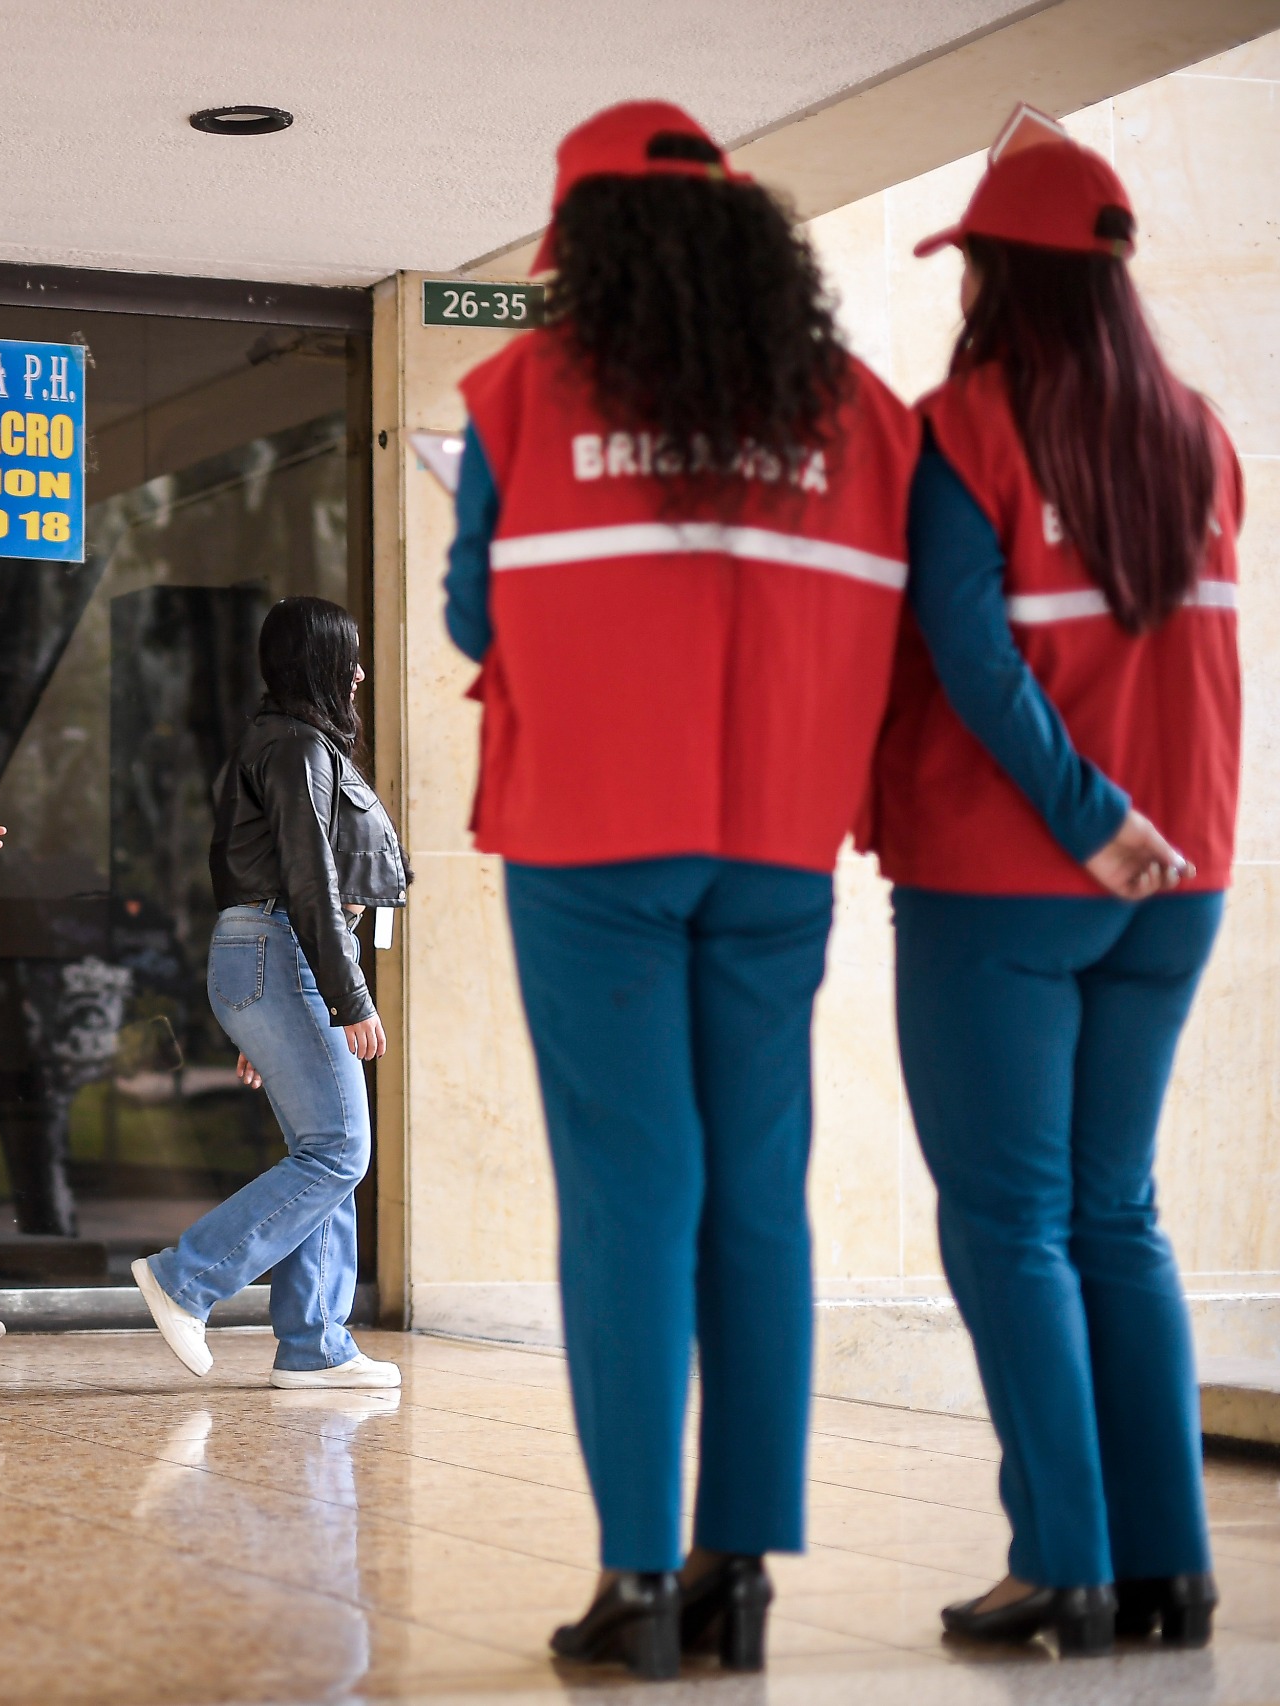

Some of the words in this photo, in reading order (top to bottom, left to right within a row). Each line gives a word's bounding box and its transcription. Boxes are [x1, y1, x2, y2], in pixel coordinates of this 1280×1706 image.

[442, 289, 528, 321] 26-35
[23, 354, 77, 403] P.H.
[18, 511, 71, 542] 18
